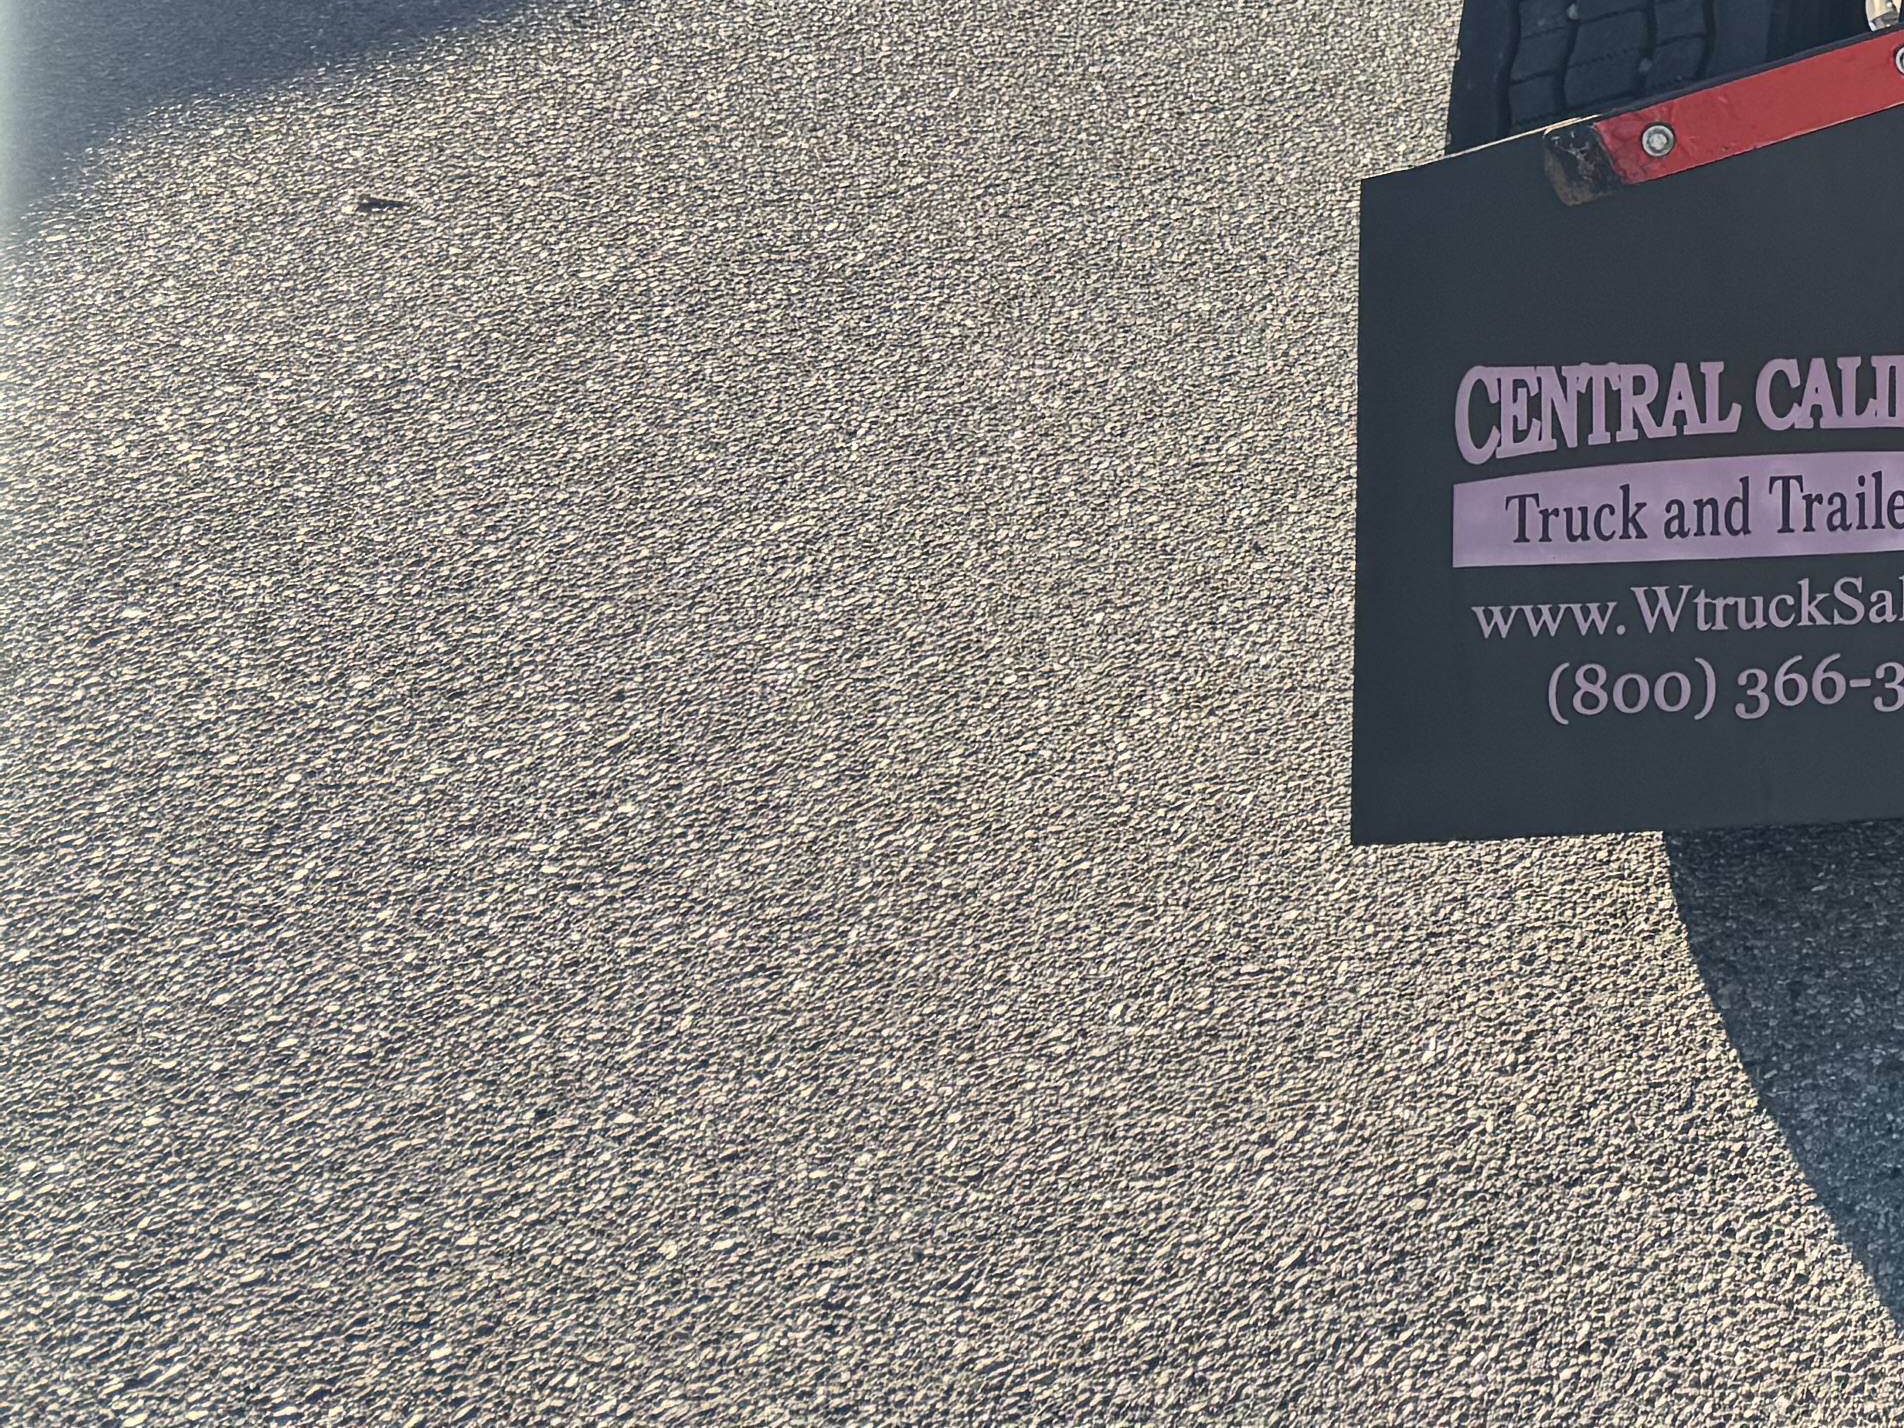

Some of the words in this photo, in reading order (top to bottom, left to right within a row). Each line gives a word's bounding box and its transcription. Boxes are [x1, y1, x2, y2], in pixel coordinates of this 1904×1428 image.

[1455, 361, 1743, 465] CENTRAL
[1505, 484, 1647, 543] Truck
[1664, 476, 1751, 539] and
[1549, 658, 1715, 724] (800)
